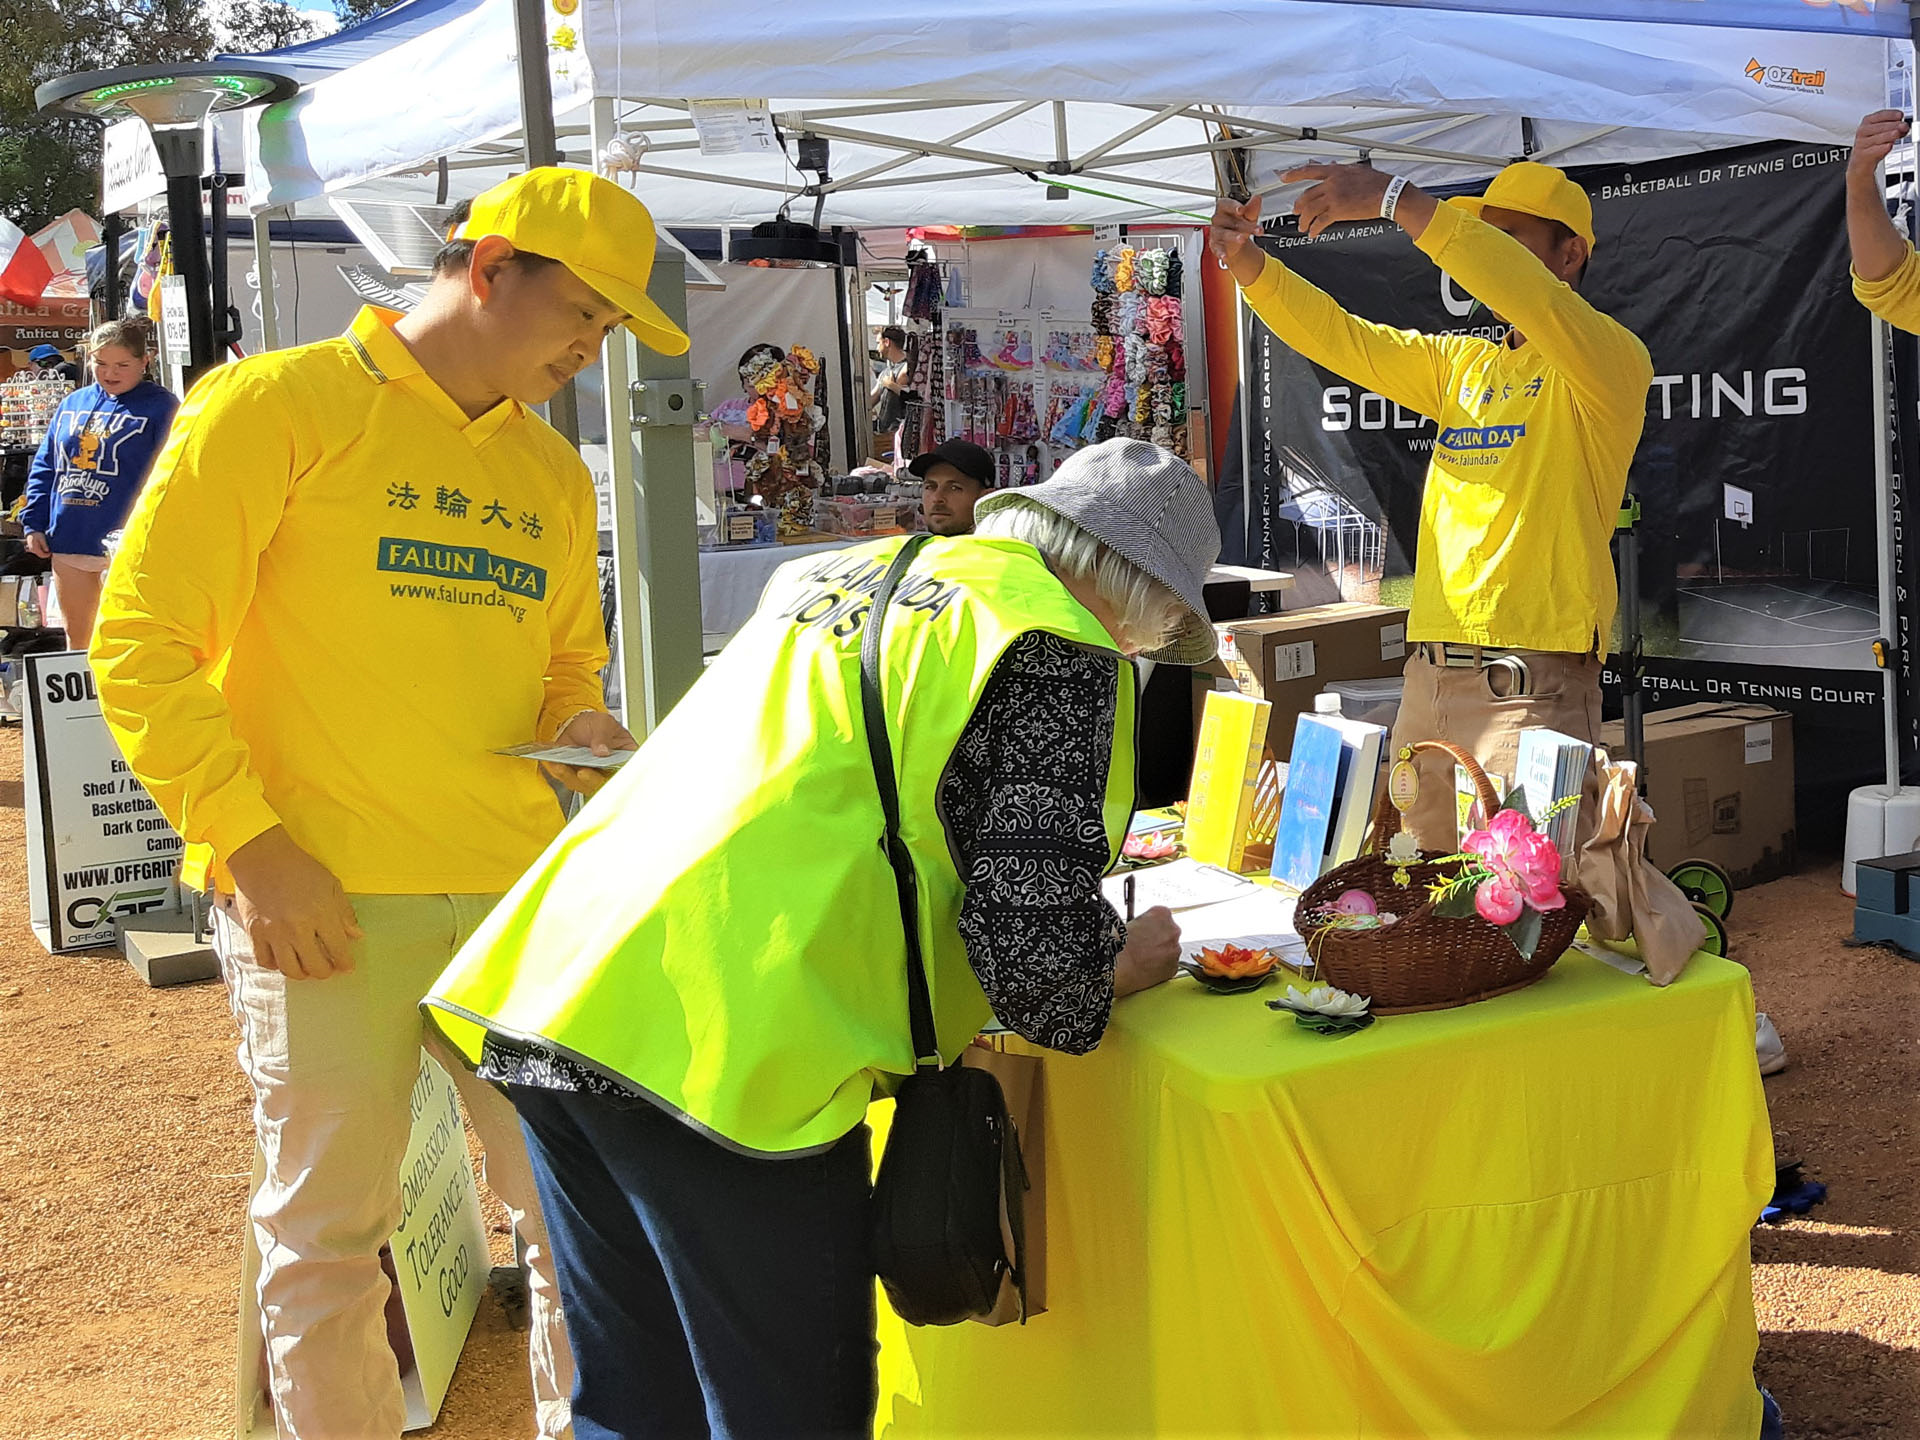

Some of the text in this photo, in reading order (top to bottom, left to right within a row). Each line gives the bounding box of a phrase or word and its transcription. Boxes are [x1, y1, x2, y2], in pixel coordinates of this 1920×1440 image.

[1767, 65, 1826, 87] OZtrail
[1602, 174, 1692, 200] BASKETBALL
[1728, 157, 1785, 180] TENNIS
[1792, 147, 1852, 169] COURT
[1348, 224, 1384, 240] ARENA
[16, 328, 60, 340] Antica
[1263, 334, 1272, 409] GARDEN
[1321, 367, 1808, 431] SOLA TING
[1263, 429, 1272, 477] AREA
[1445, 430, 1483, 447] FAUN
[58, 470, 110, 500] Brooklyn
[386, 481, 544, 540] 法輪大法
[1892, 474, 1904, 574] GARDEN
[388, 543, 476, 574] FALUN
[45, 669, 98, 704] SOL
[1602, 670, 1700, 693] BAETBALL
[1738, 681, 1802, 700] TENNIS
[1811, 687, 1876, 705] COURT
[111, 759, 131, 773] En
[83, 781, 115, 798] Shed
[129, 778, 146, 792] M
[92, 798, 157, 818] Basketba
[103, 819, 134, 838] Dark
[147, 835, 184, 852] Camp
[63, 859, 177, 891] WWW.OFFGRID
[406, 1169, 464, 1292] TOLERANCE
[439, 1242, 469, 1318] GOOD
